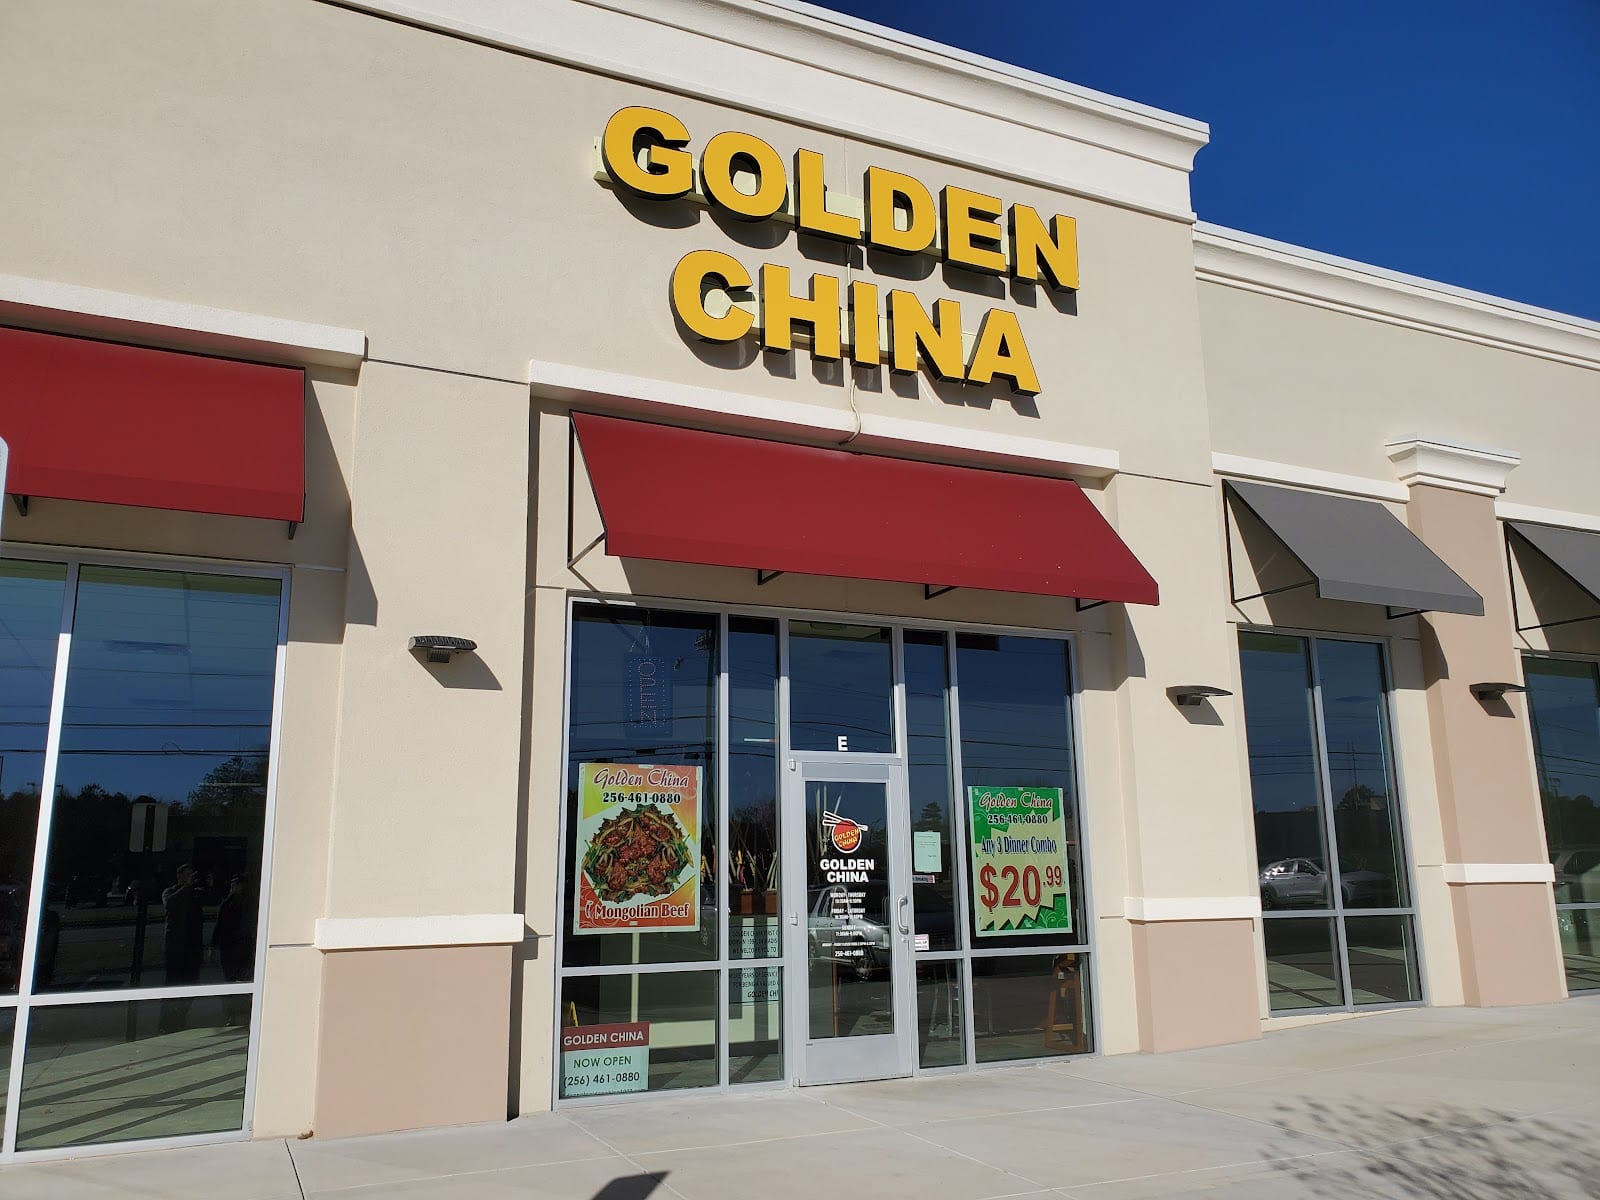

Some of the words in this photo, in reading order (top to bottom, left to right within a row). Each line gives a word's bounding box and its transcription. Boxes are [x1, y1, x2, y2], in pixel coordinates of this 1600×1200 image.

[602, 106, 1080, 291] GOLDEN
[670, 250, 1041, 396] CHINA
[837, 735, 848, 751] E
[593, 768, 643, 789] Golden
[647, 768, 689, 787] China
[602, 791, 681, 803] 256-461-0880
[979, 792, 1017, 810] Golden
[1020, 791, 1052, 808] China
[987, 813, 1048, 824] 256-461-0880
[834, 828, 860, 842] GOLDEN
[981, 837, 995, 857] Any
[997, 837, 1003, 853] 3
[1004, 837, 1029, 853] Dinner
[1031, 836, 1058, 855] Combo
[820, 858, 875, 871] GOLDEN
[826, 871, 869, 883] CHINA
[979, 862, 1063, 913] $20.99
[586, 901, 659, 920] Mongolian
[661, 903, 689, 917] Beef
[563, 1033, 608, 1046] GOLDEN
[610, 1031, 644, 1042] CHINA
[573, 1057, 600, 1068] NOW
[603, 1055, 632, 1066] OPEN
[563, 1074, 590, 1088] (256)
[592, 1071, 640, 1083] 461-0880
